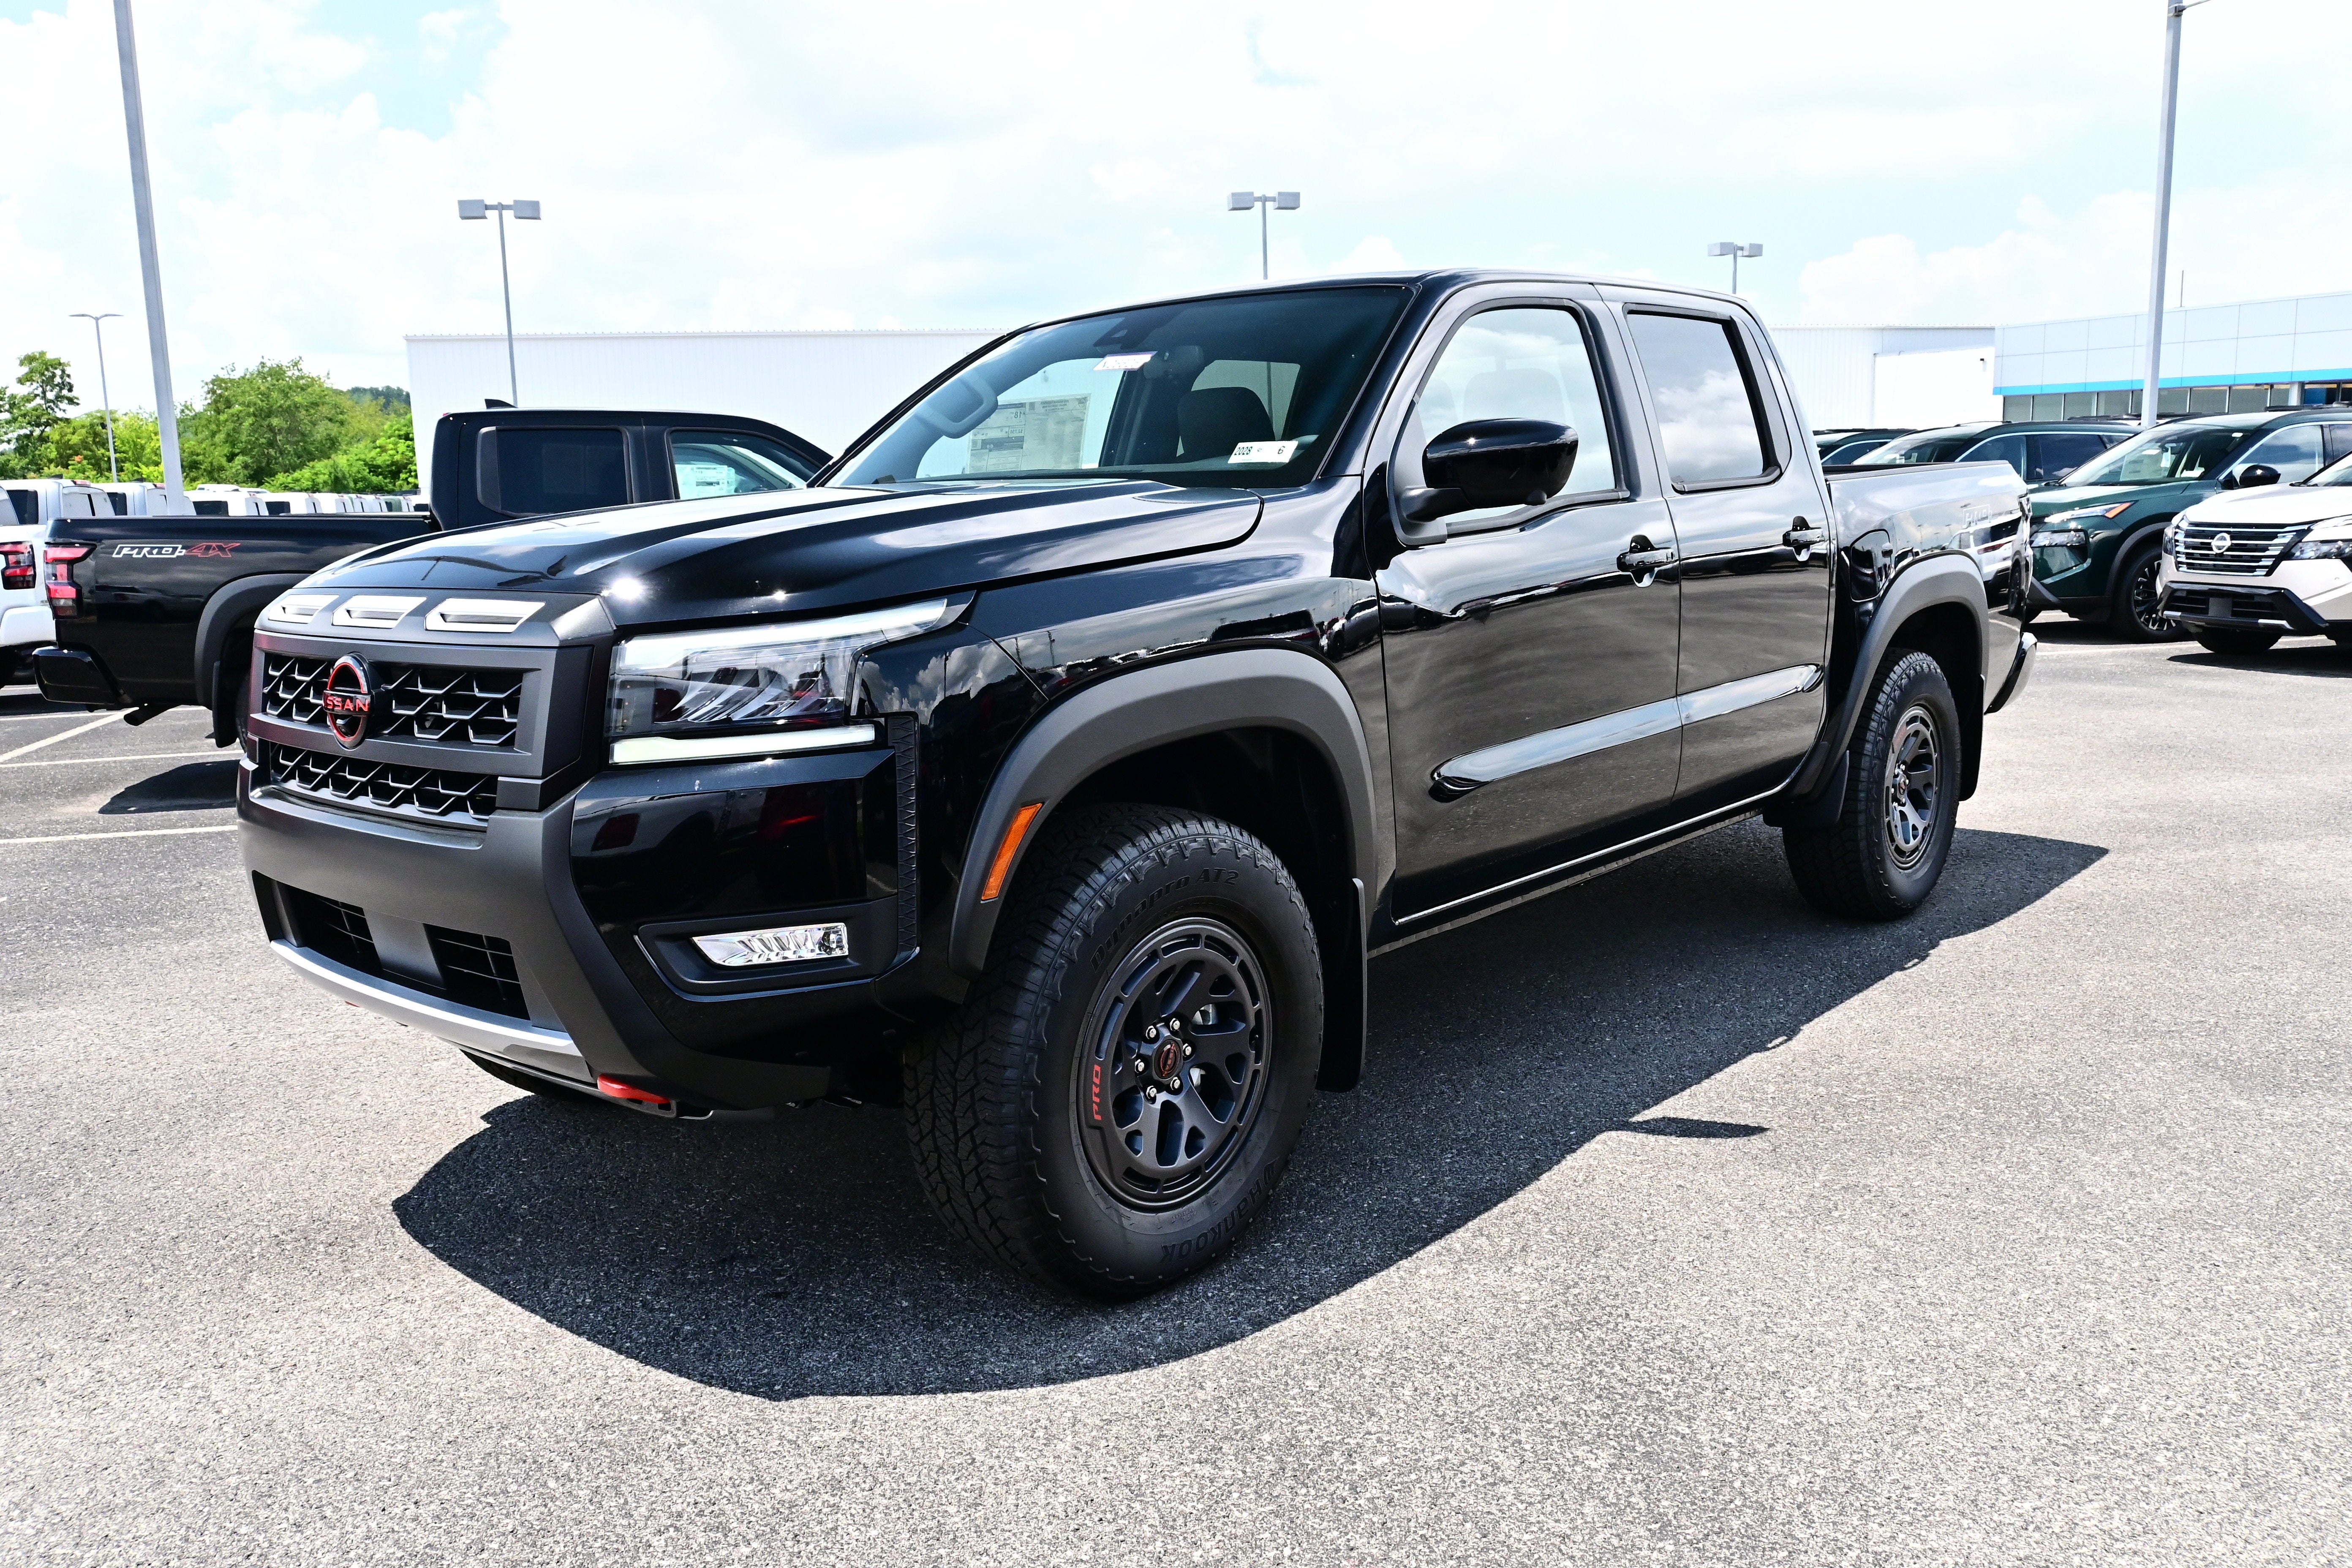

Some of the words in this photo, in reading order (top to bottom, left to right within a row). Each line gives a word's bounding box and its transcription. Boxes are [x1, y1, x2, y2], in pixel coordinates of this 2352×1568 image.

[1234, 446, 1253, 455] 2028
[1277, 446, 1285, 455] 6
[323, 696, 370, 711] SSAN
[1195, 867, 1239, 886] AT2
[1092, 1064, 1102, 1121] PRO
